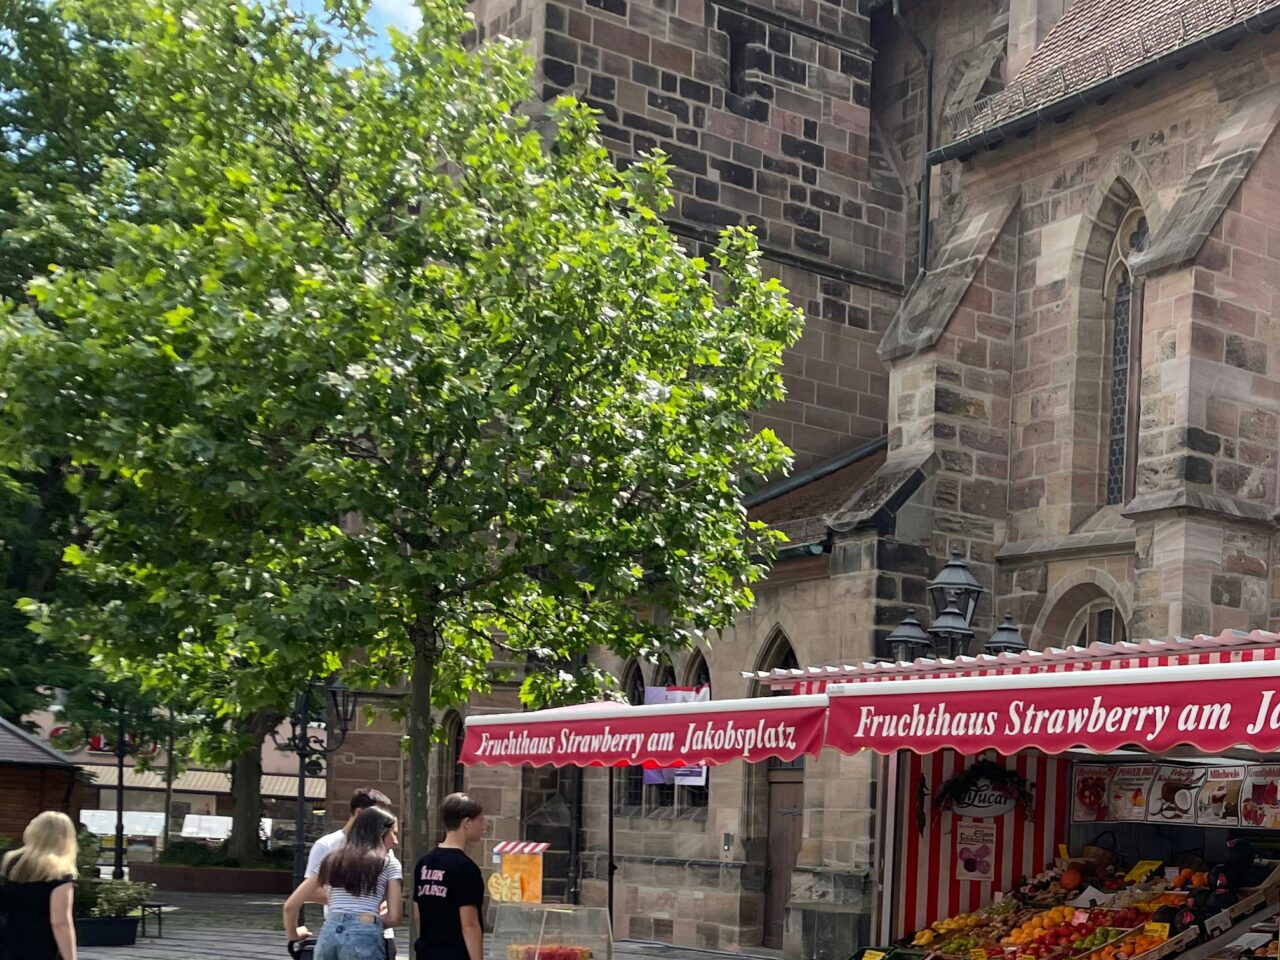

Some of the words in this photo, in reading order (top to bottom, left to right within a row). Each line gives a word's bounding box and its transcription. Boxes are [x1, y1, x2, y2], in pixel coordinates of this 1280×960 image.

[475, 730, 555, 756] Fruchthaus
[557, 725, 642, 759] Strawberry
[647, 732, 674, 753] am
[680, 719, 797, 757] Jakobsplatz
[854, 699, 998, 739] Fruchthaus
[1003, 696, 1171, 742] Strawberry
[1178, 702, 1231, 732] am
